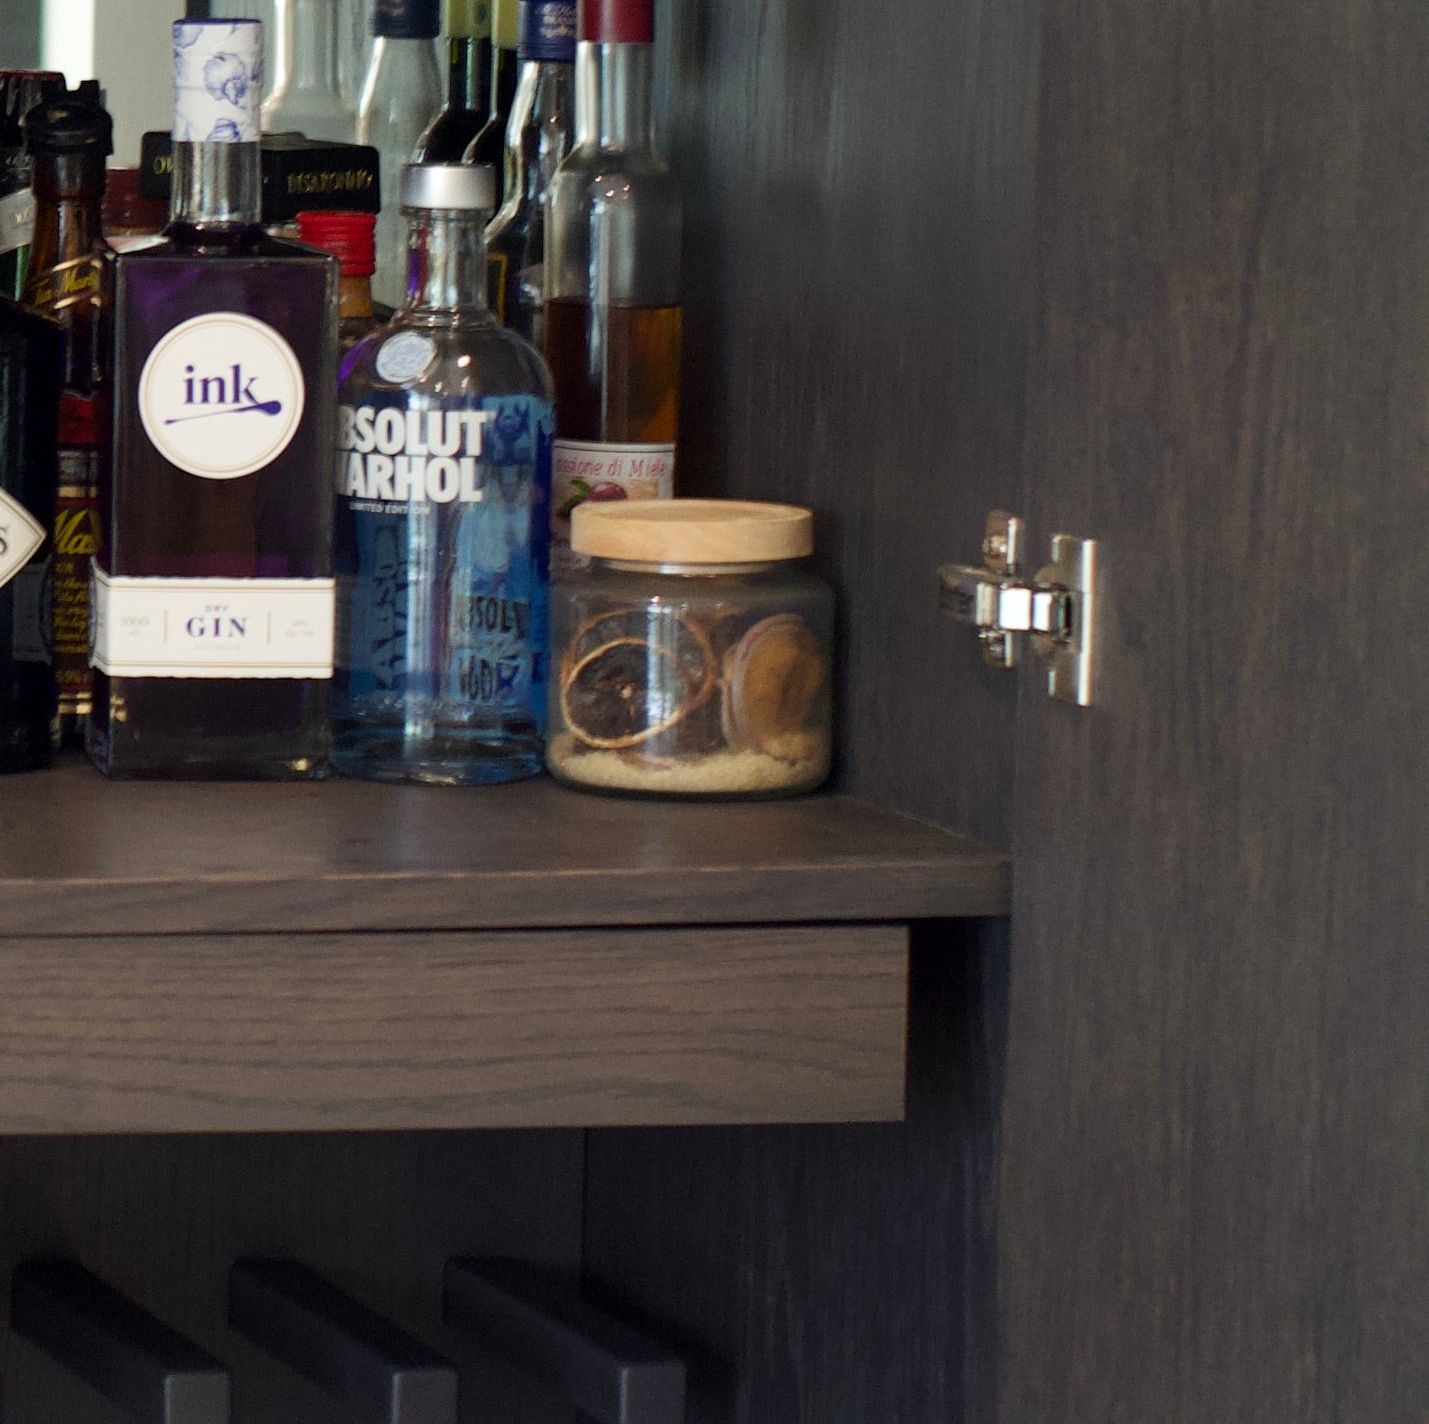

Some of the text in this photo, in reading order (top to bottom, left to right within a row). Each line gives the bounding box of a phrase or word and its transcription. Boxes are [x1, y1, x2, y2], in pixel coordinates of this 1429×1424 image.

[182, 362, 259, 406] ink
[340, 404, 488, 458] BSOLUT
[184, 616, 248, 639] GIN
